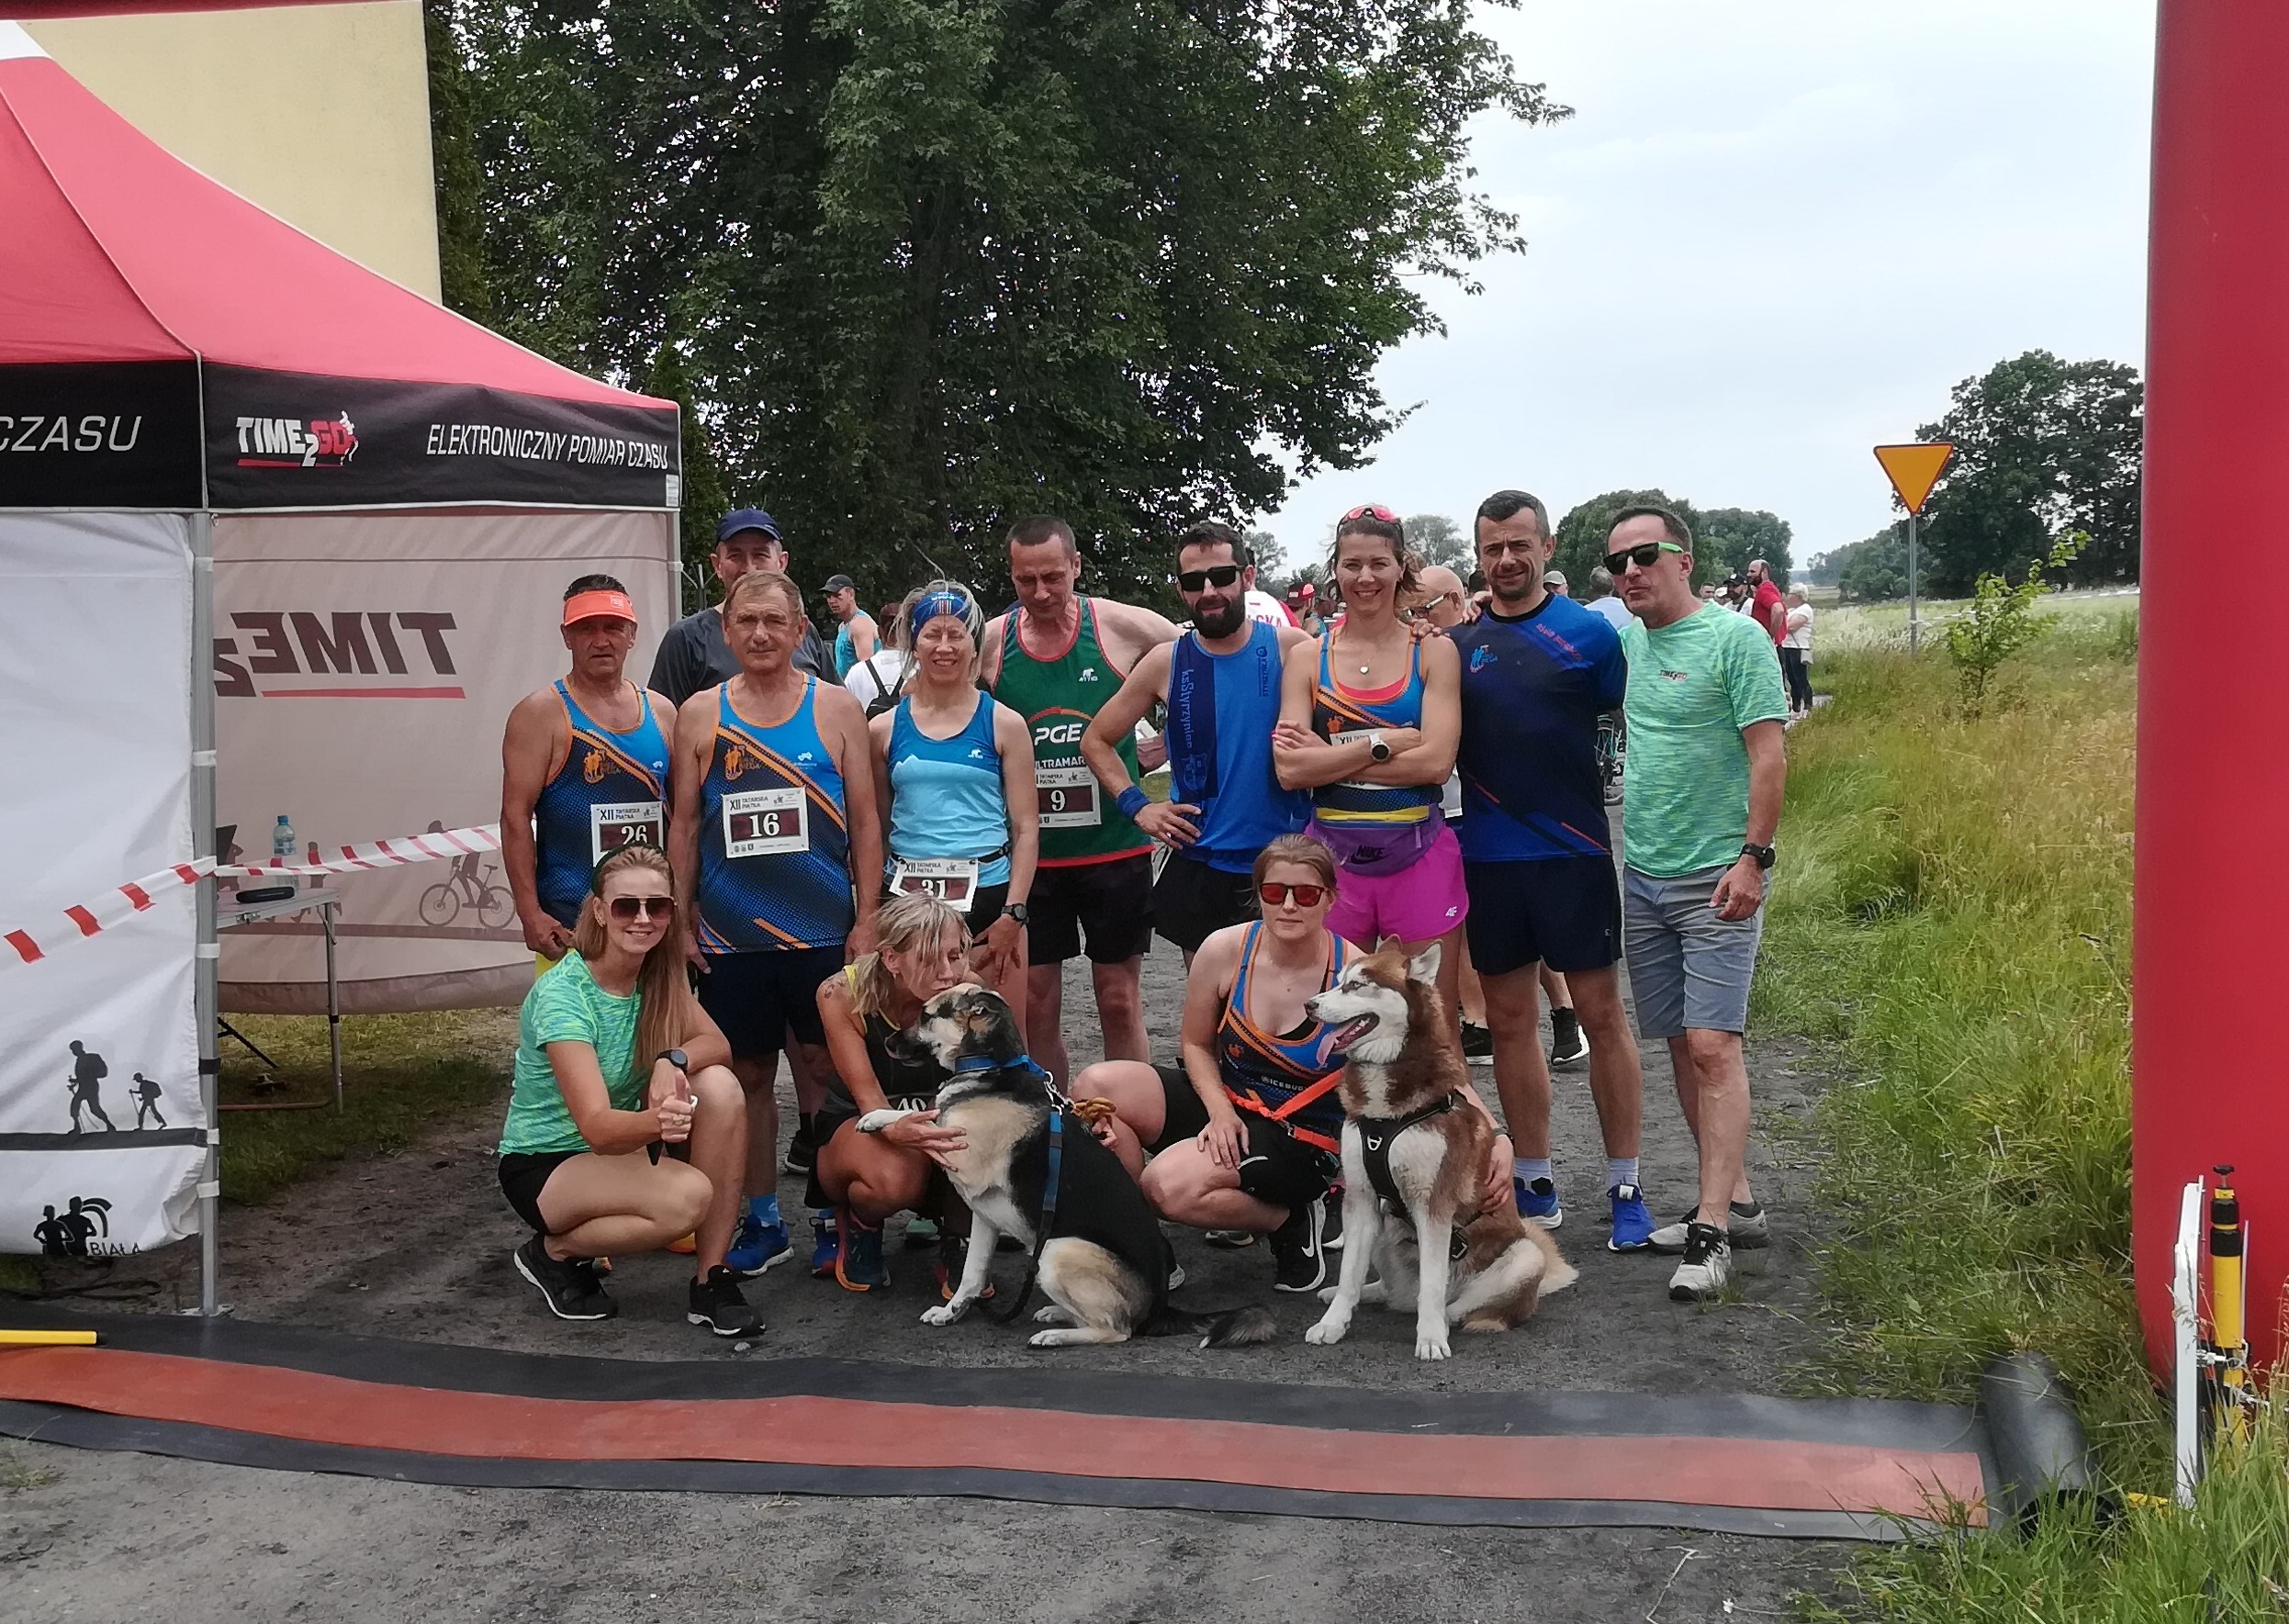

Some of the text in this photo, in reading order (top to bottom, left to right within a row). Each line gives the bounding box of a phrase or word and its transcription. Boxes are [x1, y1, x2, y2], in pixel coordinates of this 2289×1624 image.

[426, 424, 668, 469] ELEKTRONICZNY POMIAR CZASU
[1034, 723, 1083, 745] PGE
[730, 799, 741, 811] XII
[1050, 790, 1066, 812] 9
[600, 810, 614, 821] XII
[749, 812, 780, 837] 16
[621, 824, 648, 846] 26
[904, 863, 916, 873] XII
[921, 879, 947, 900] 31
